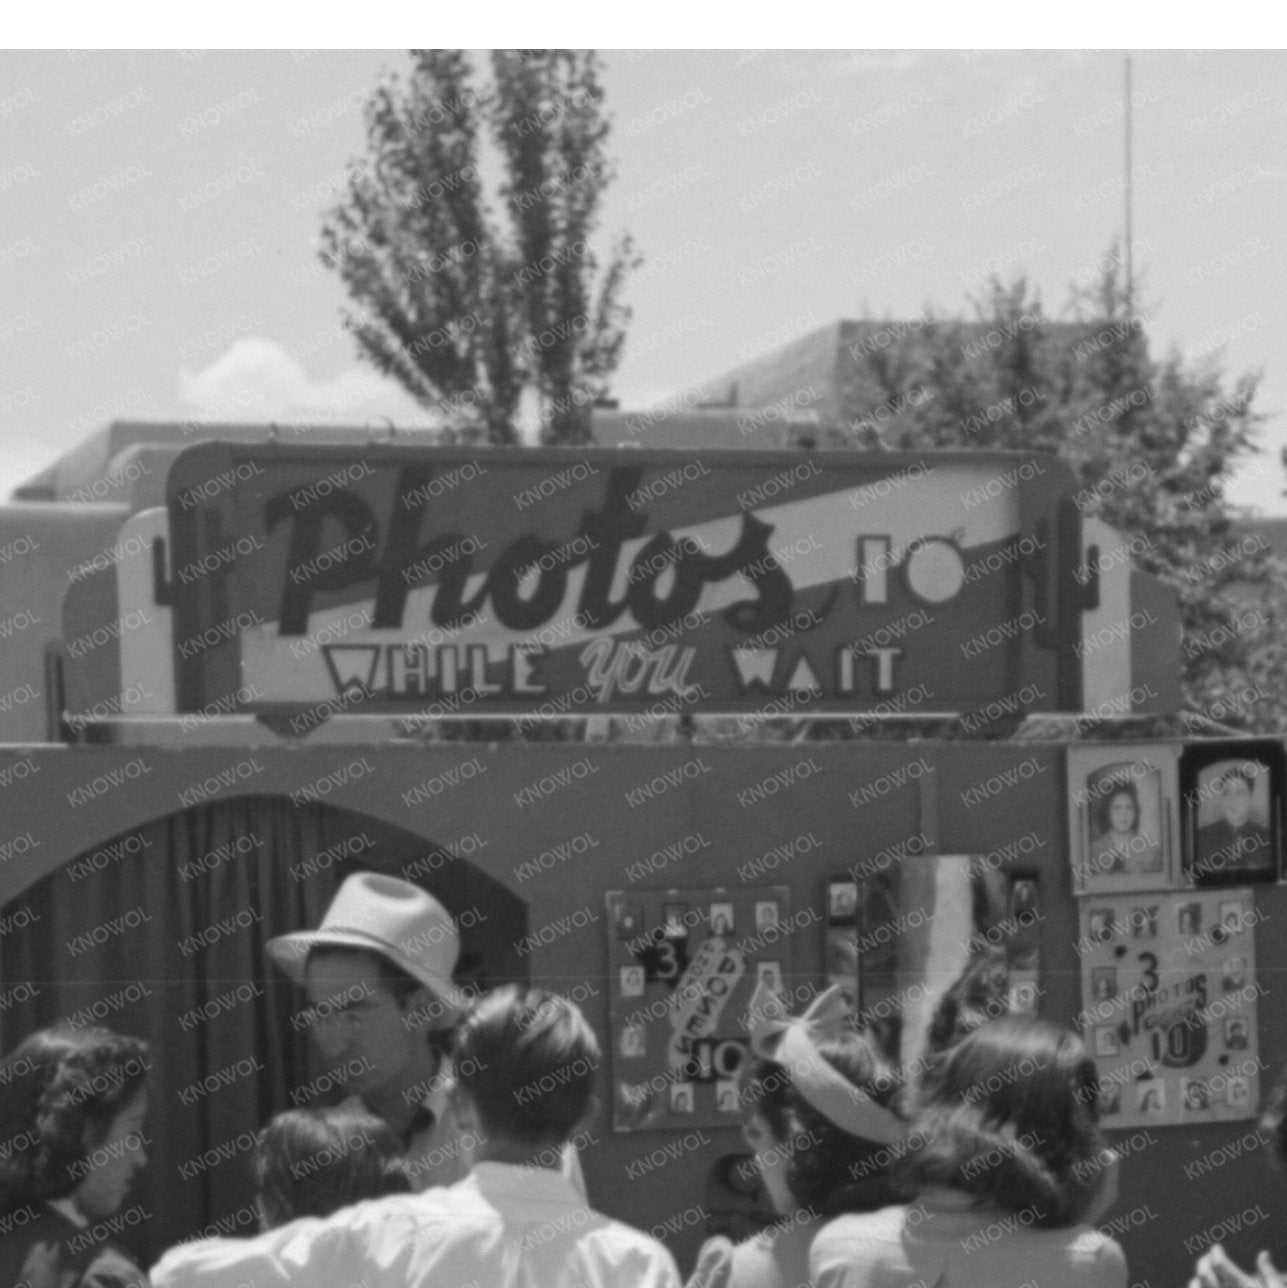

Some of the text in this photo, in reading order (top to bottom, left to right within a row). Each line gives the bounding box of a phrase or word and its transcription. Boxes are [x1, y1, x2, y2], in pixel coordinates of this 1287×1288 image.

[264, 464, 838, 636] Photos
[321, 635, 901, 702] WHILE you WAIT
[655, 941, 678, 978] 3
[1137, 951, 1159, 992] 3
[698, 1040, 748, 1078] 10
[1151, 1022, 1198, 1063] 10
